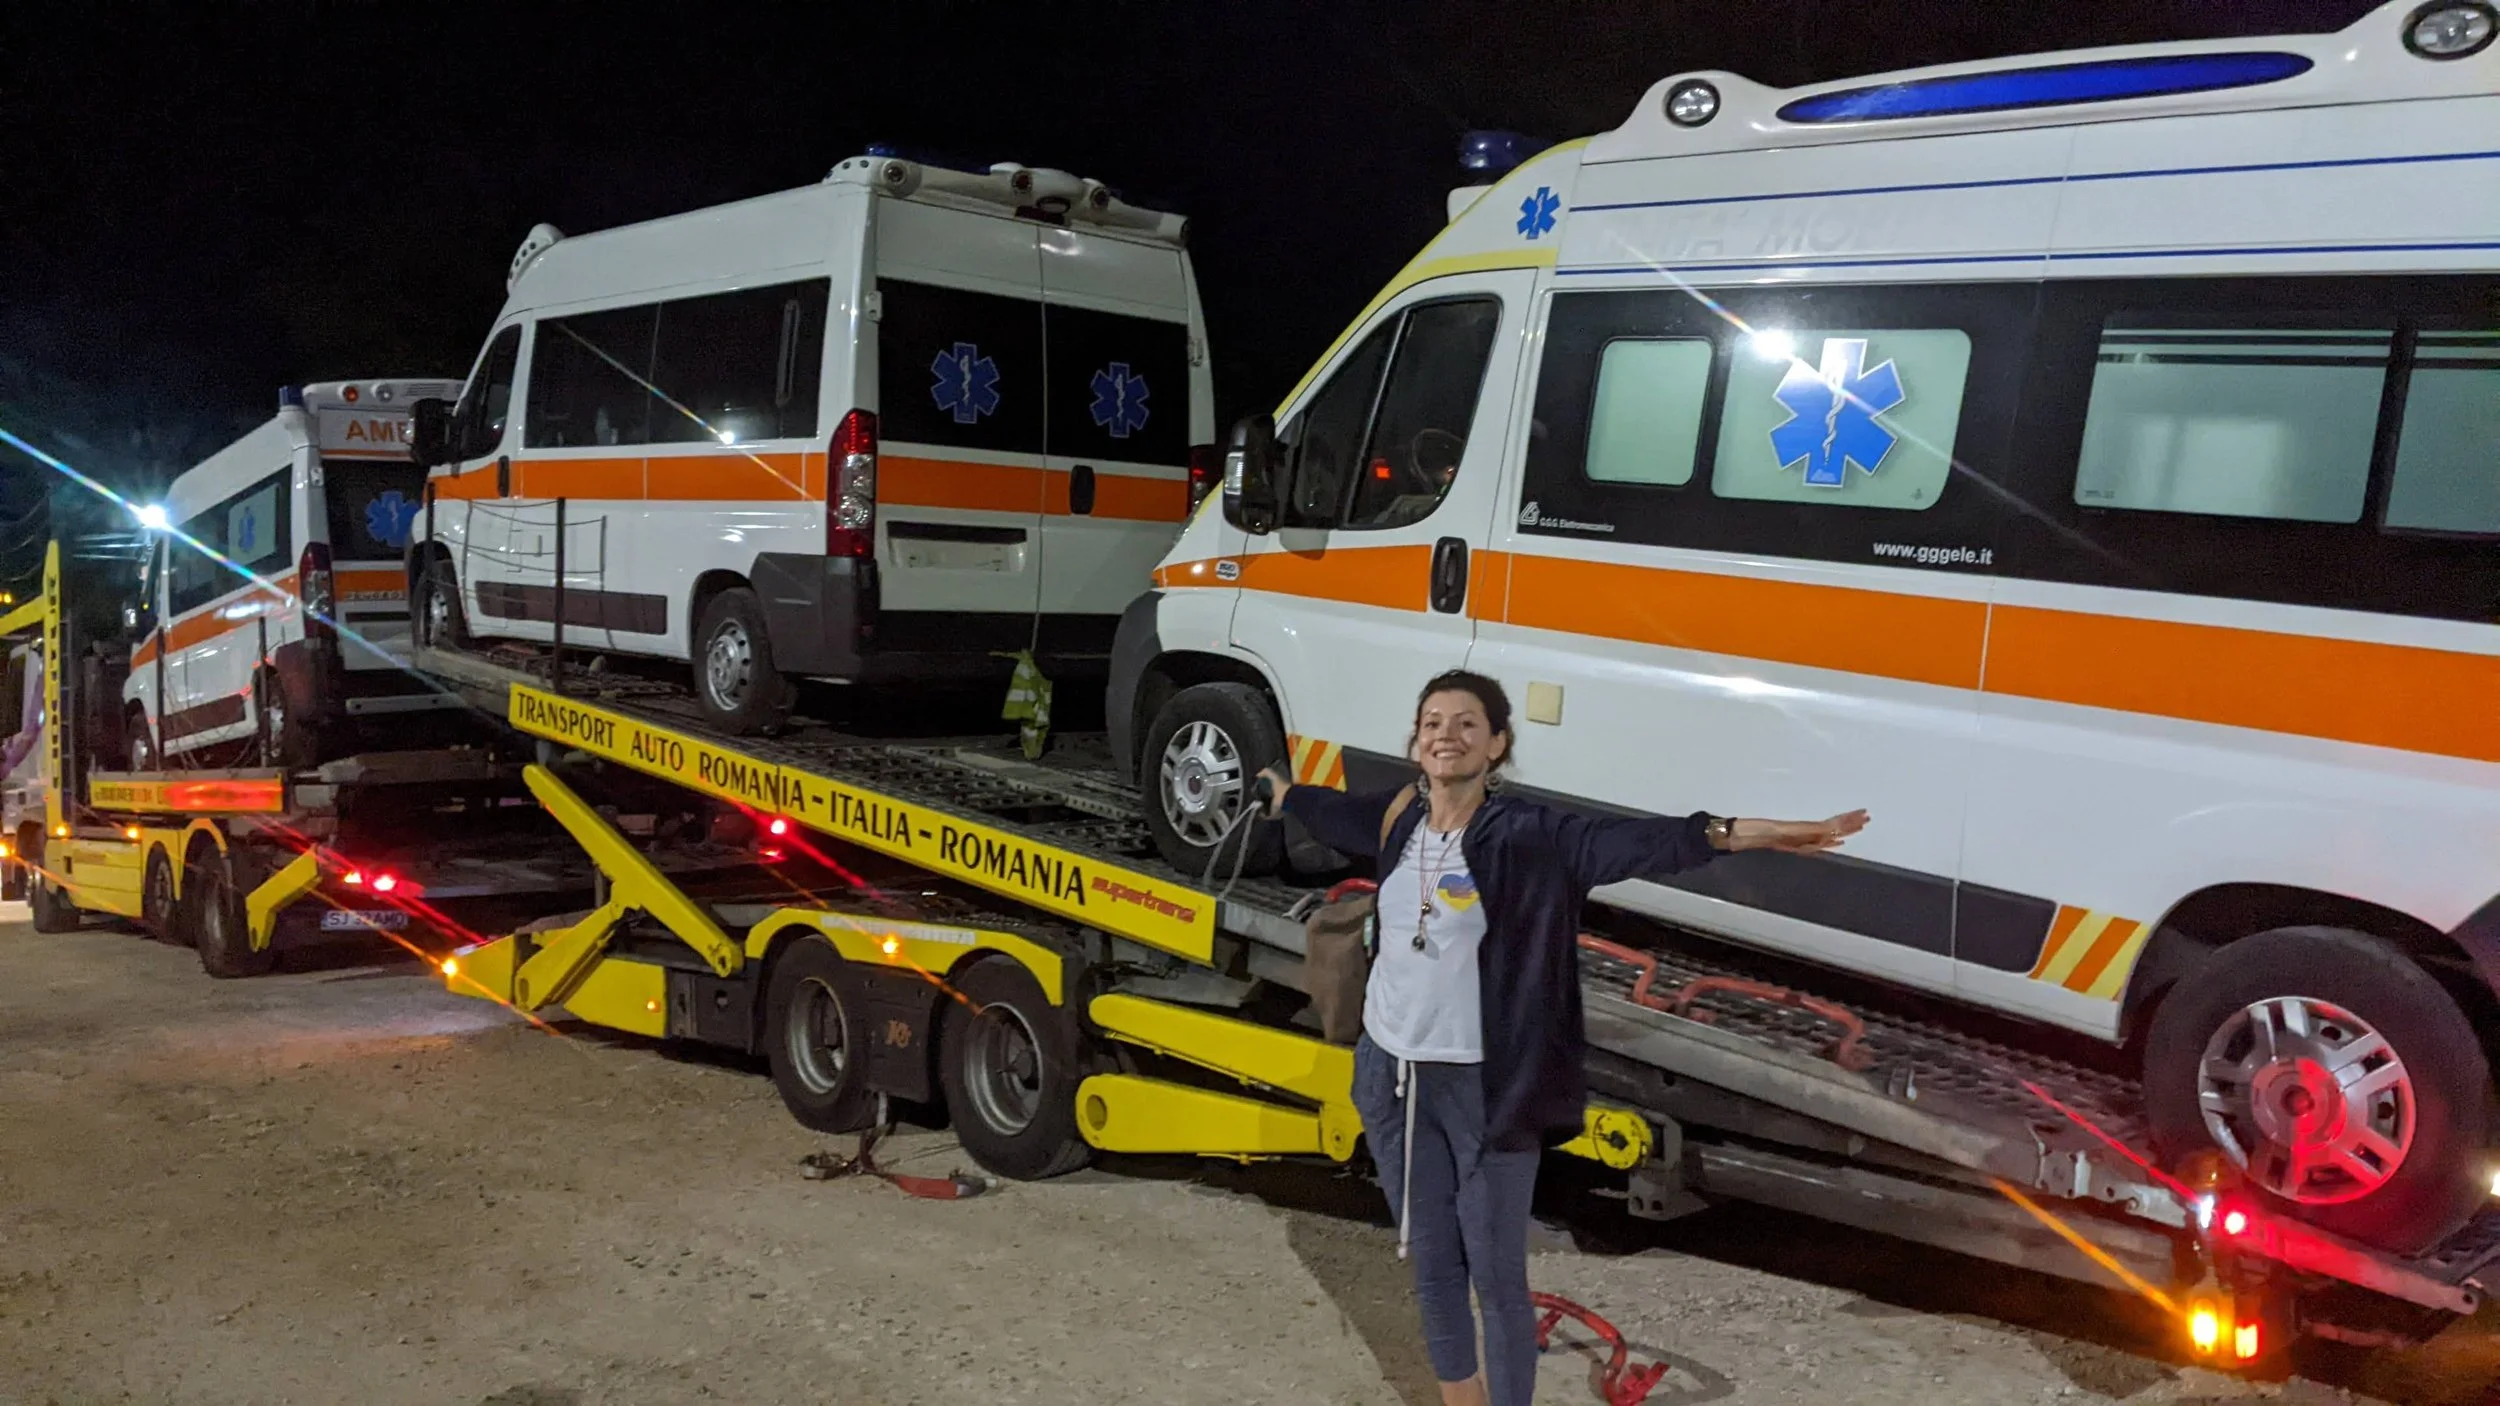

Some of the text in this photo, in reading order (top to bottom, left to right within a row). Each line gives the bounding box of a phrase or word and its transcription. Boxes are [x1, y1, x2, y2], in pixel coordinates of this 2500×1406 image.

[1873, 542, 1993, 565] www.gggele.it
[517, 692, 616, 749] TRANSPORT
[630, 730, 684, 772] AUTO
[700, 752, 806, 812] ROMANIA
[829, 790, 912, 848] ITALIA
[940, 825, 1086, 906] ROMANIA
